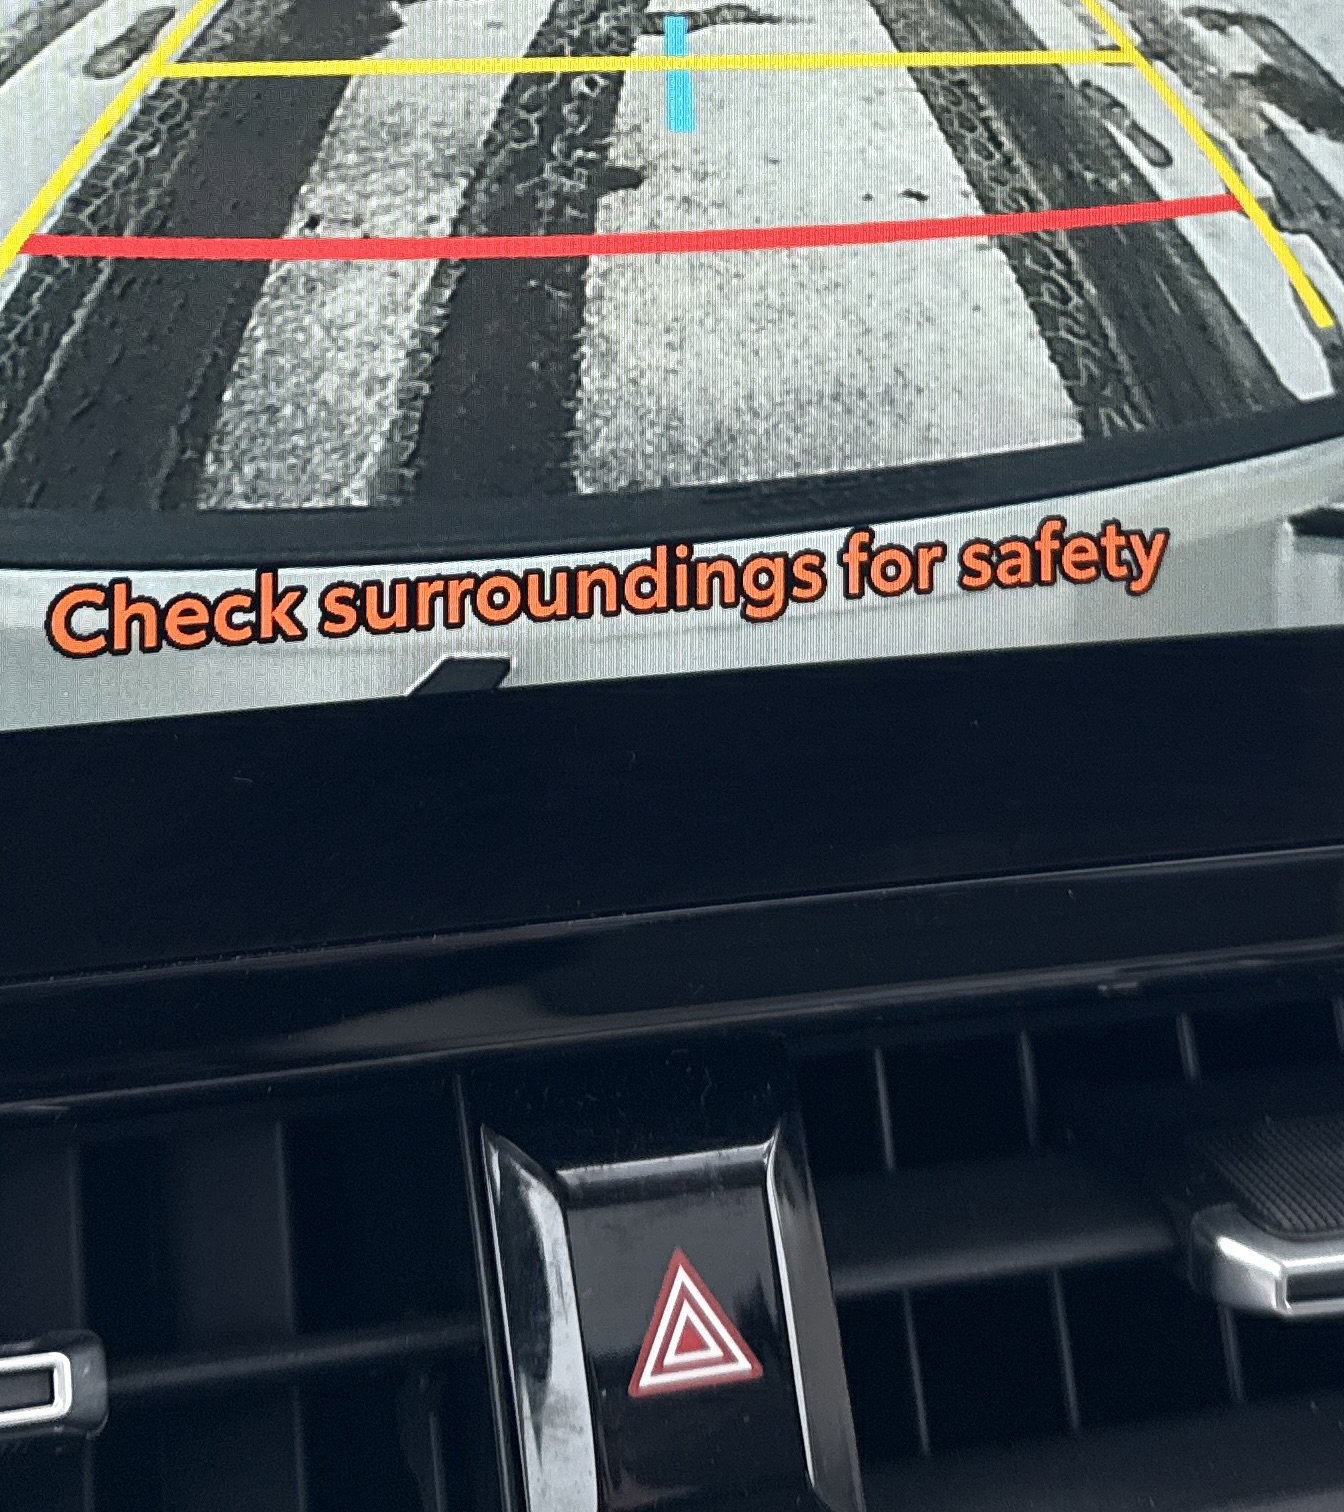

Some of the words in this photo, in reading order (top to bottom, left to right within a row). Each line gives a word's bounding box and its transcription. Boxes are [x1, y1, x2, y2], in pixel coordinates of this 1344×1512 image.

[45, 567, 308, 658] Check
[318, 543, 826, 638] surroundings
[841, 525, 947, 598] for
[957, 515, 1170, 596] safety
